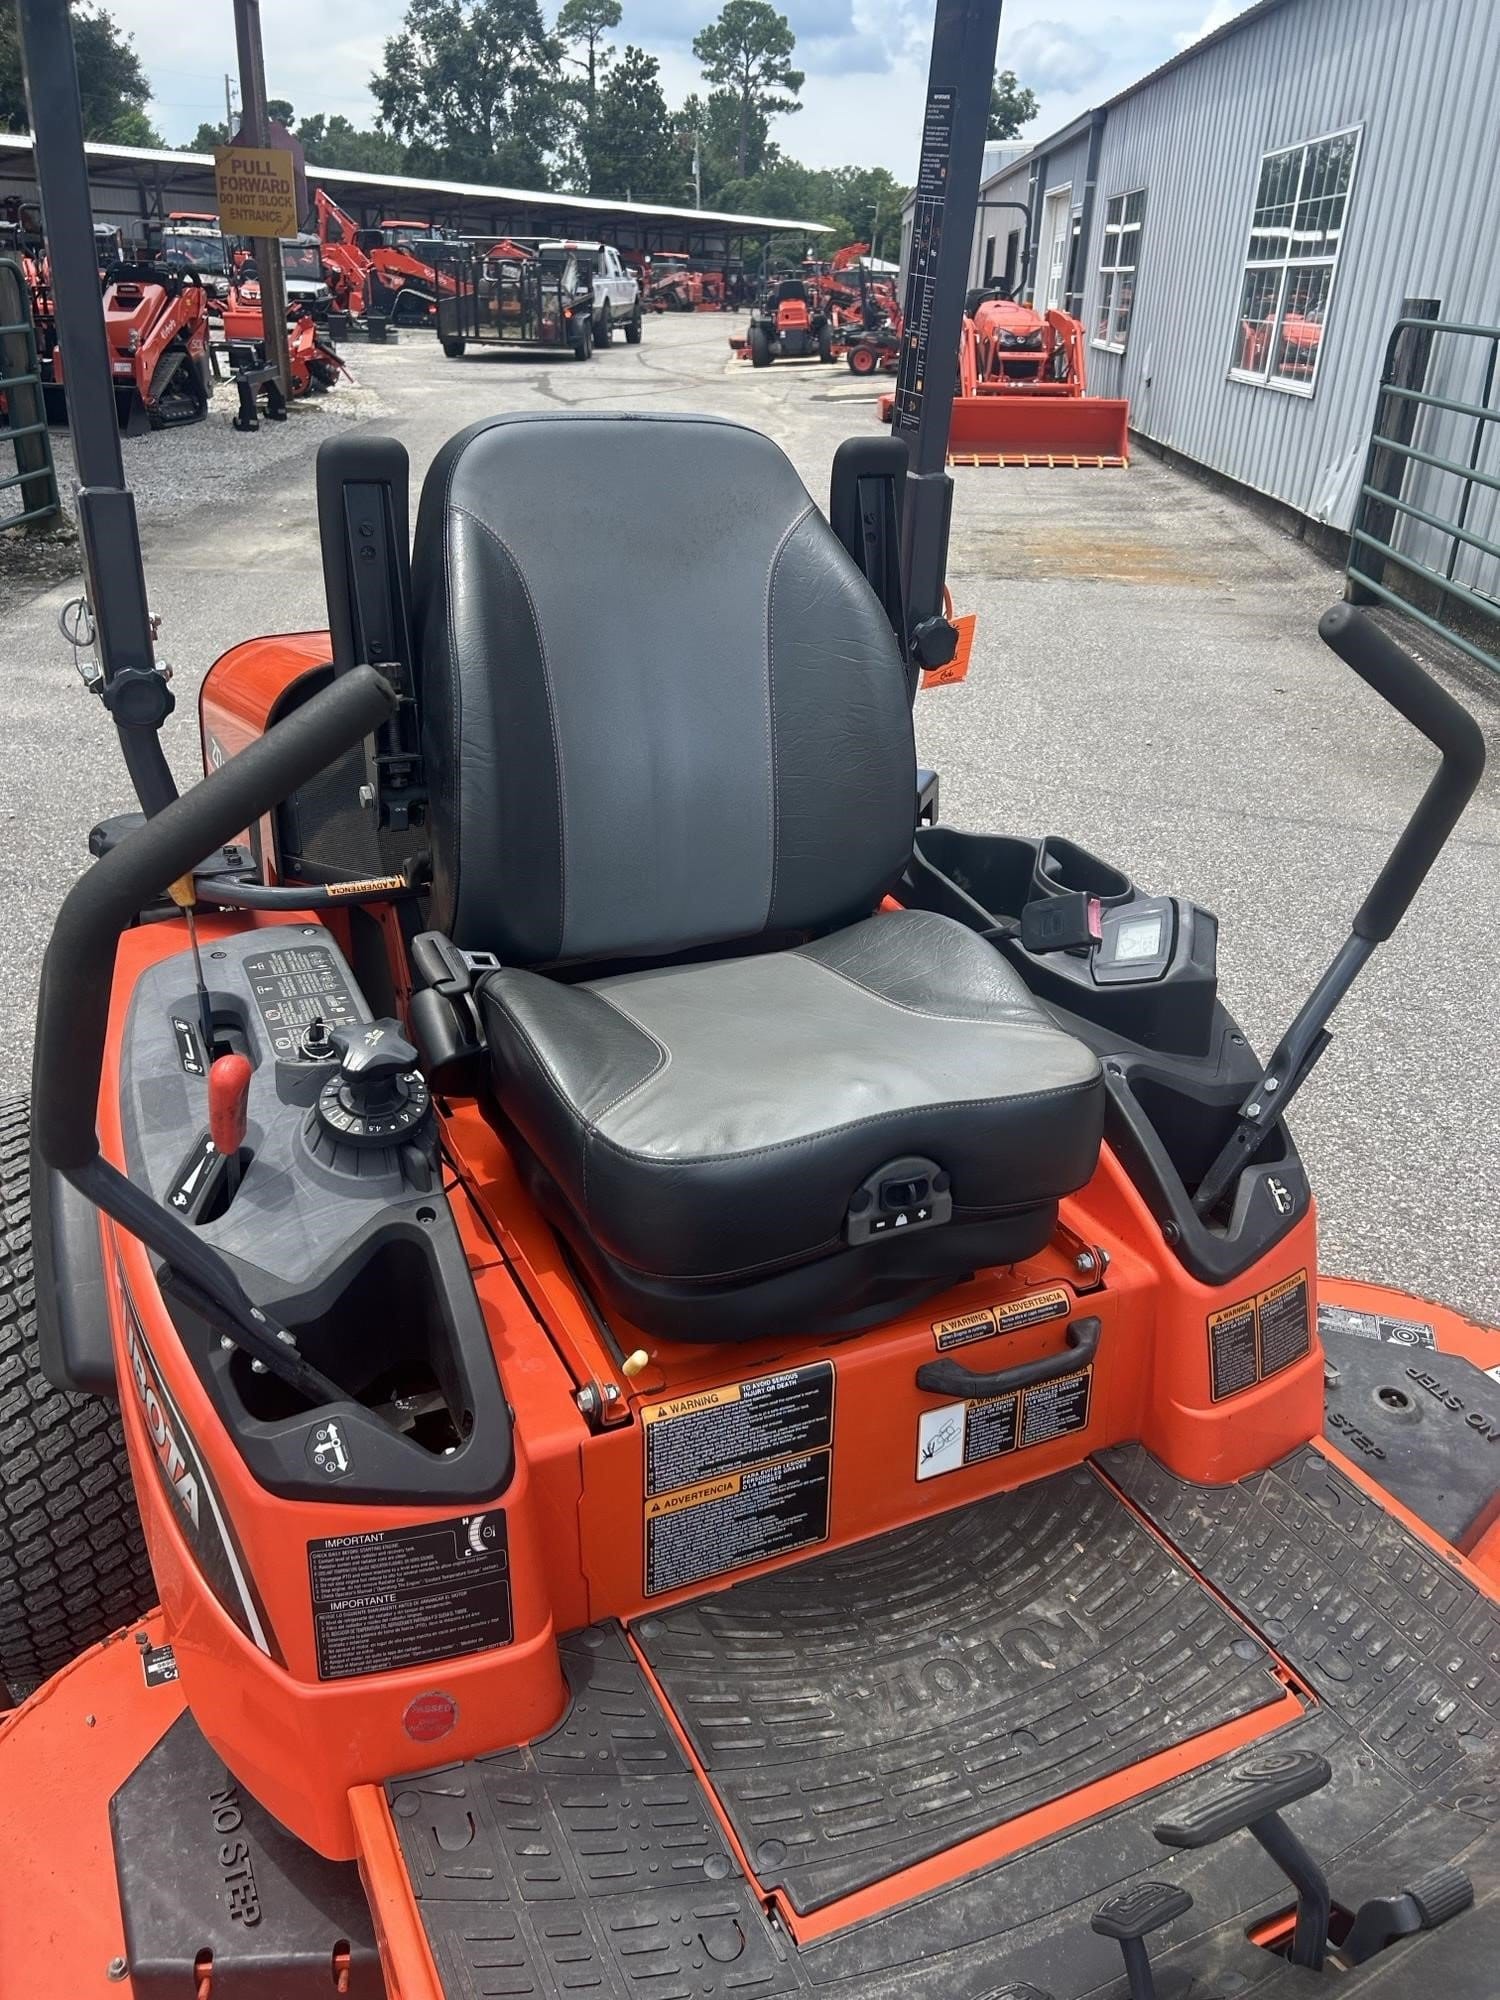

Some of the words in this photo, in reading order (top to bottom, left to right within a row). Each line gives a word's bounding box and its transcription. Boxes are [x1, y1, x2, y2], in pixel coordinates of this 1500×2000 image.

[231, 160, 277, 177] PULL
[220, 176, 290, 194] FORWARD
[220, 193, 233, 205] DO
[236, 193, 256, 205] NOT
[258, 195, 292, 208] BLOCK
[230, 208, 282, 222] ENTRANCE
[331, 882, 388, 895] ADVERTENCIA
[400, 1113, 409, 1122] 4
[1270, 1274, 1301, 1298] ADVERTENCIA
[1008, 1292, 1063, 1313] ADVERTENCIA
[1223, 1302, 1249, 1319] WARNING
[949, 1312, 988, 1330] WARNING
[742, 1384, 750, 1392] TO
[752, 1379, 770, 1389] AVOID
[771, 1372, 798, 1384] SERIOUS
[743, 1386, 765, 1397] INJURY
[766, 1384, 775, 1392] OR
[776, 1379, 796, 1390] DEATH
[1406, 1367, 1465, 1411] STEP
[669, 1393, 719, 1414] WARNING
[1327, 1413, 1387, 1460] STEP
[664, 1481, 734, 1510] ADVERTENCIA
[462, 1517, 469, 1525] H
[325, 1532, 385, 1548] IMPORTANT
[464, 1549, 472, 1557] C
[330, 1594, 397, 1611] IMPORTANTE
[208, 1786, 242, 1834] NO
[218, 1838, 262, 1927] STEP
